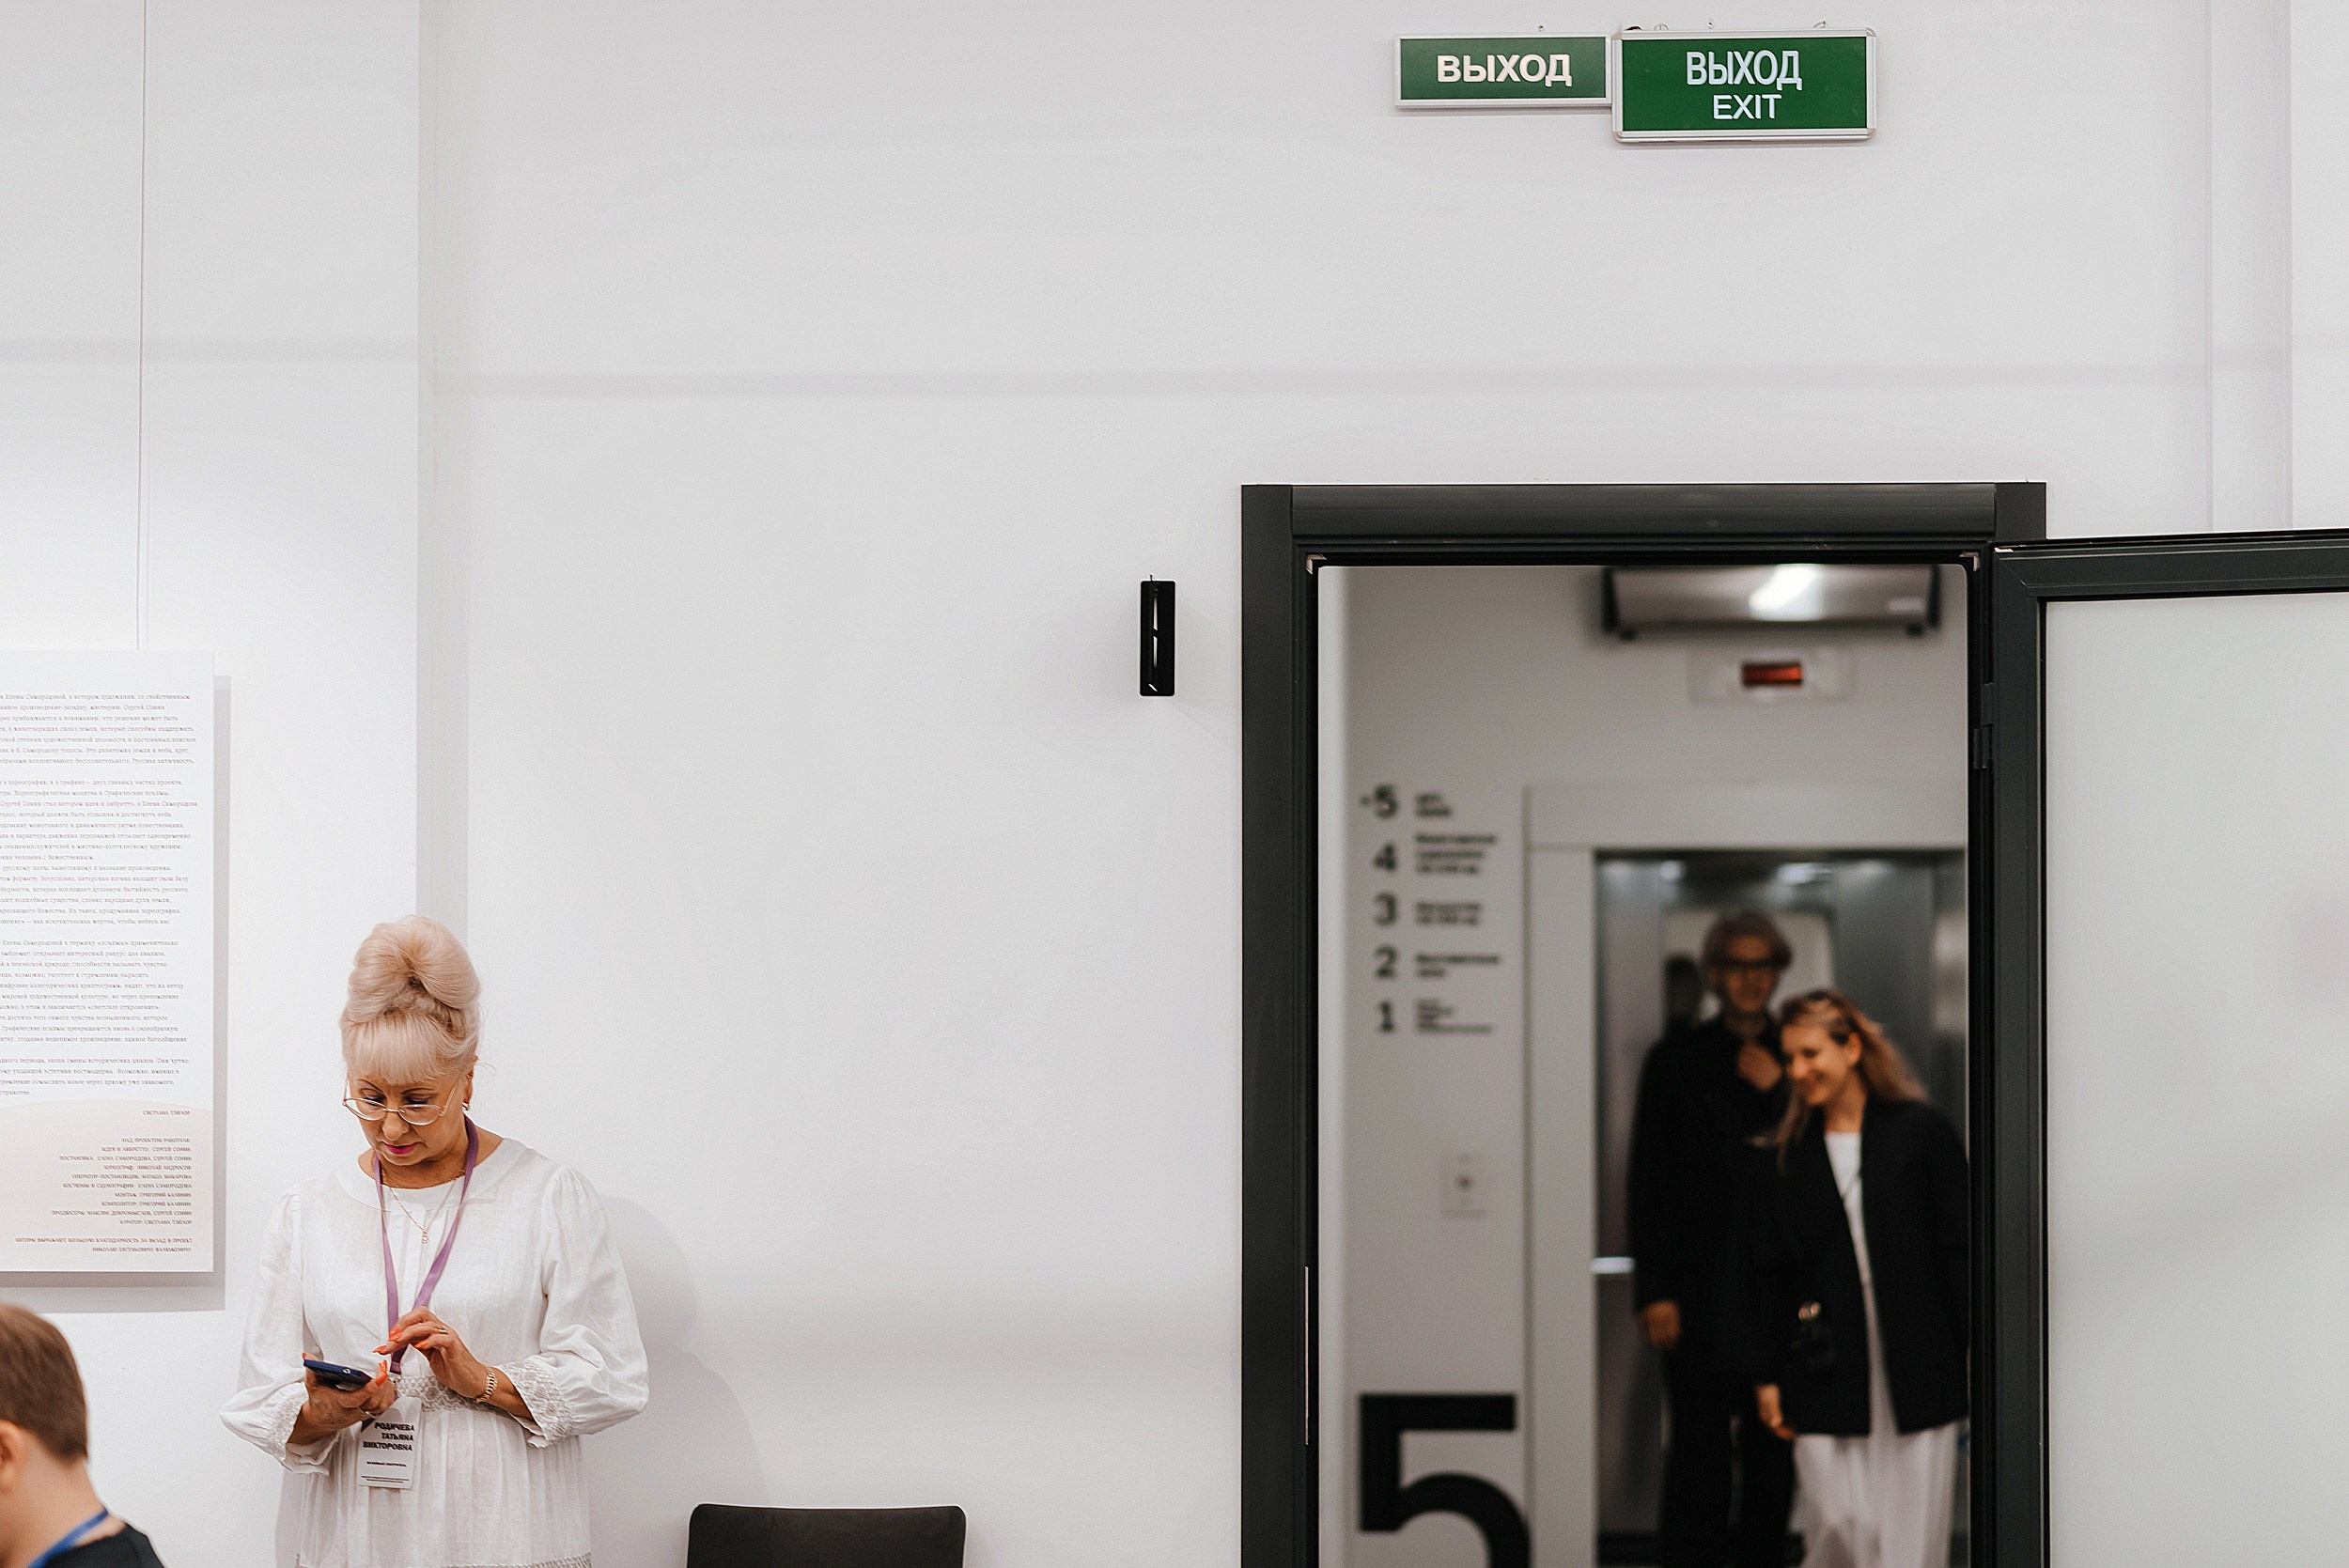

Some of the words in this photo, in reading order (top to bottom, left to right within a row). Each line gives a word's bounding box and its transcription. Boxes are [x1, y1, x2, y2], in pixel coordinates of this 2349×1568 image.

[1437, 54, 1573, 87] ВЫХОД
[1686, 50, 1803, 91] ВЫХОД
[1713, 94, 1782, 120] EXIT
[1374, 784, 1399, 818] 5
[1373, 843, 1397, 872] 4
[1374, 892, 1397, 926] 3
[1374, 942, 1398, 978] 2
[1377, 997, 1397, 1032] 1
[374, 1421, 415, 1432] РОДИЧЕВА
[381, 1433, 413, 1441] ТАТЬЯНА
[363, 1441, 412, 1451] ВИКТОРОВНА
[1359, 1393, 1532, 1568] 5
